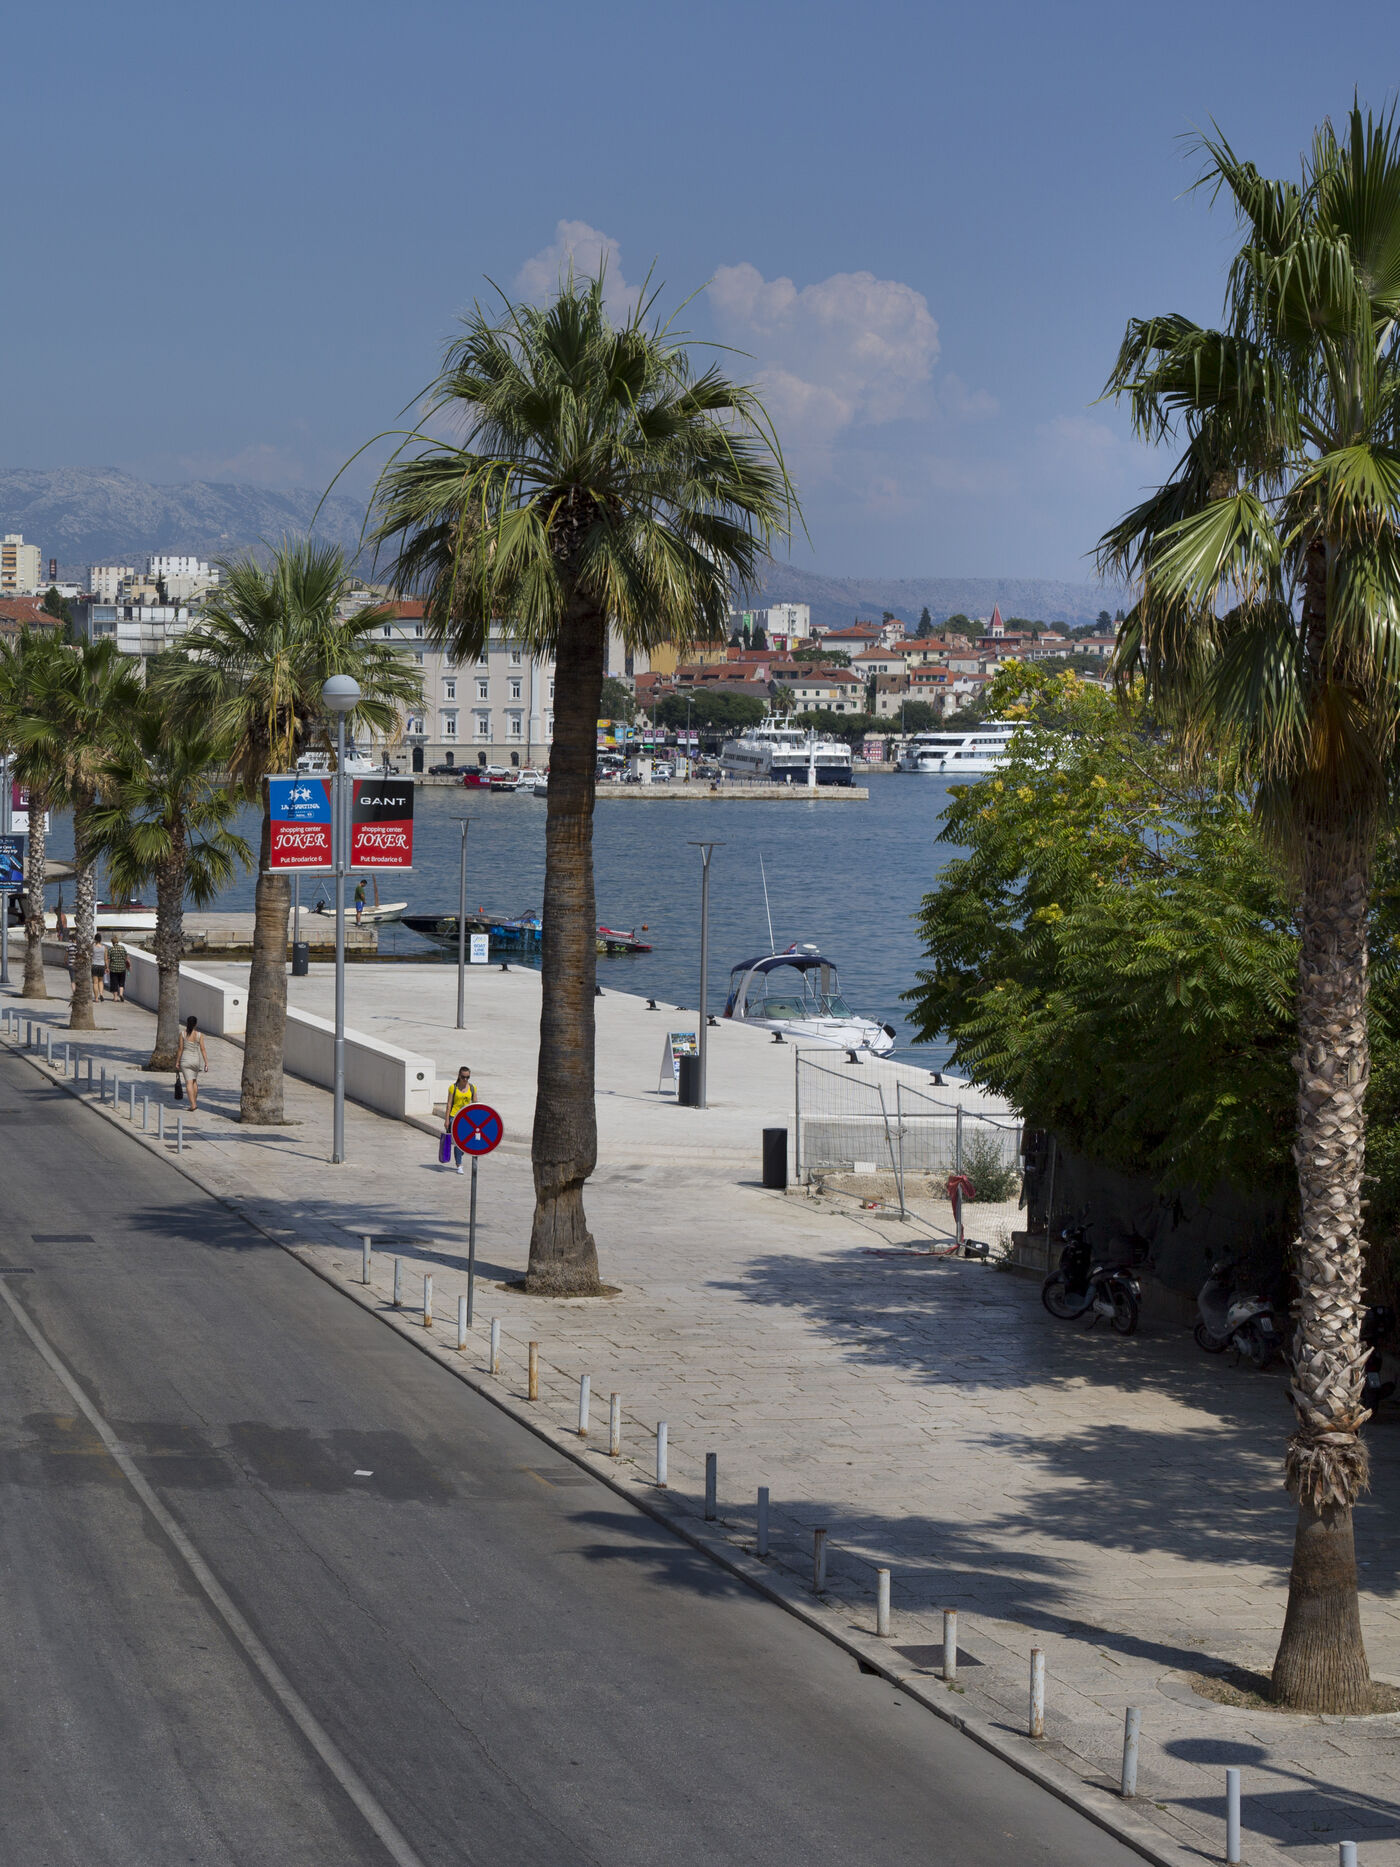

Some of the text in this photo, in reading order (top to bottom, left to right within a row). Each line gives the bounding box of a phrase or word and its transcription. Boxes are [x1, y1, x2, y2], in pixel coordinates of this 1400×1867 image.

[360, 797, 406, 806] GANT
[280, 826, 305, 834] shopping
[361, 826, 386, 834] shopping
[274, 833, 328, 850] JOKER
[354, 833, 409, 850] JOKER
